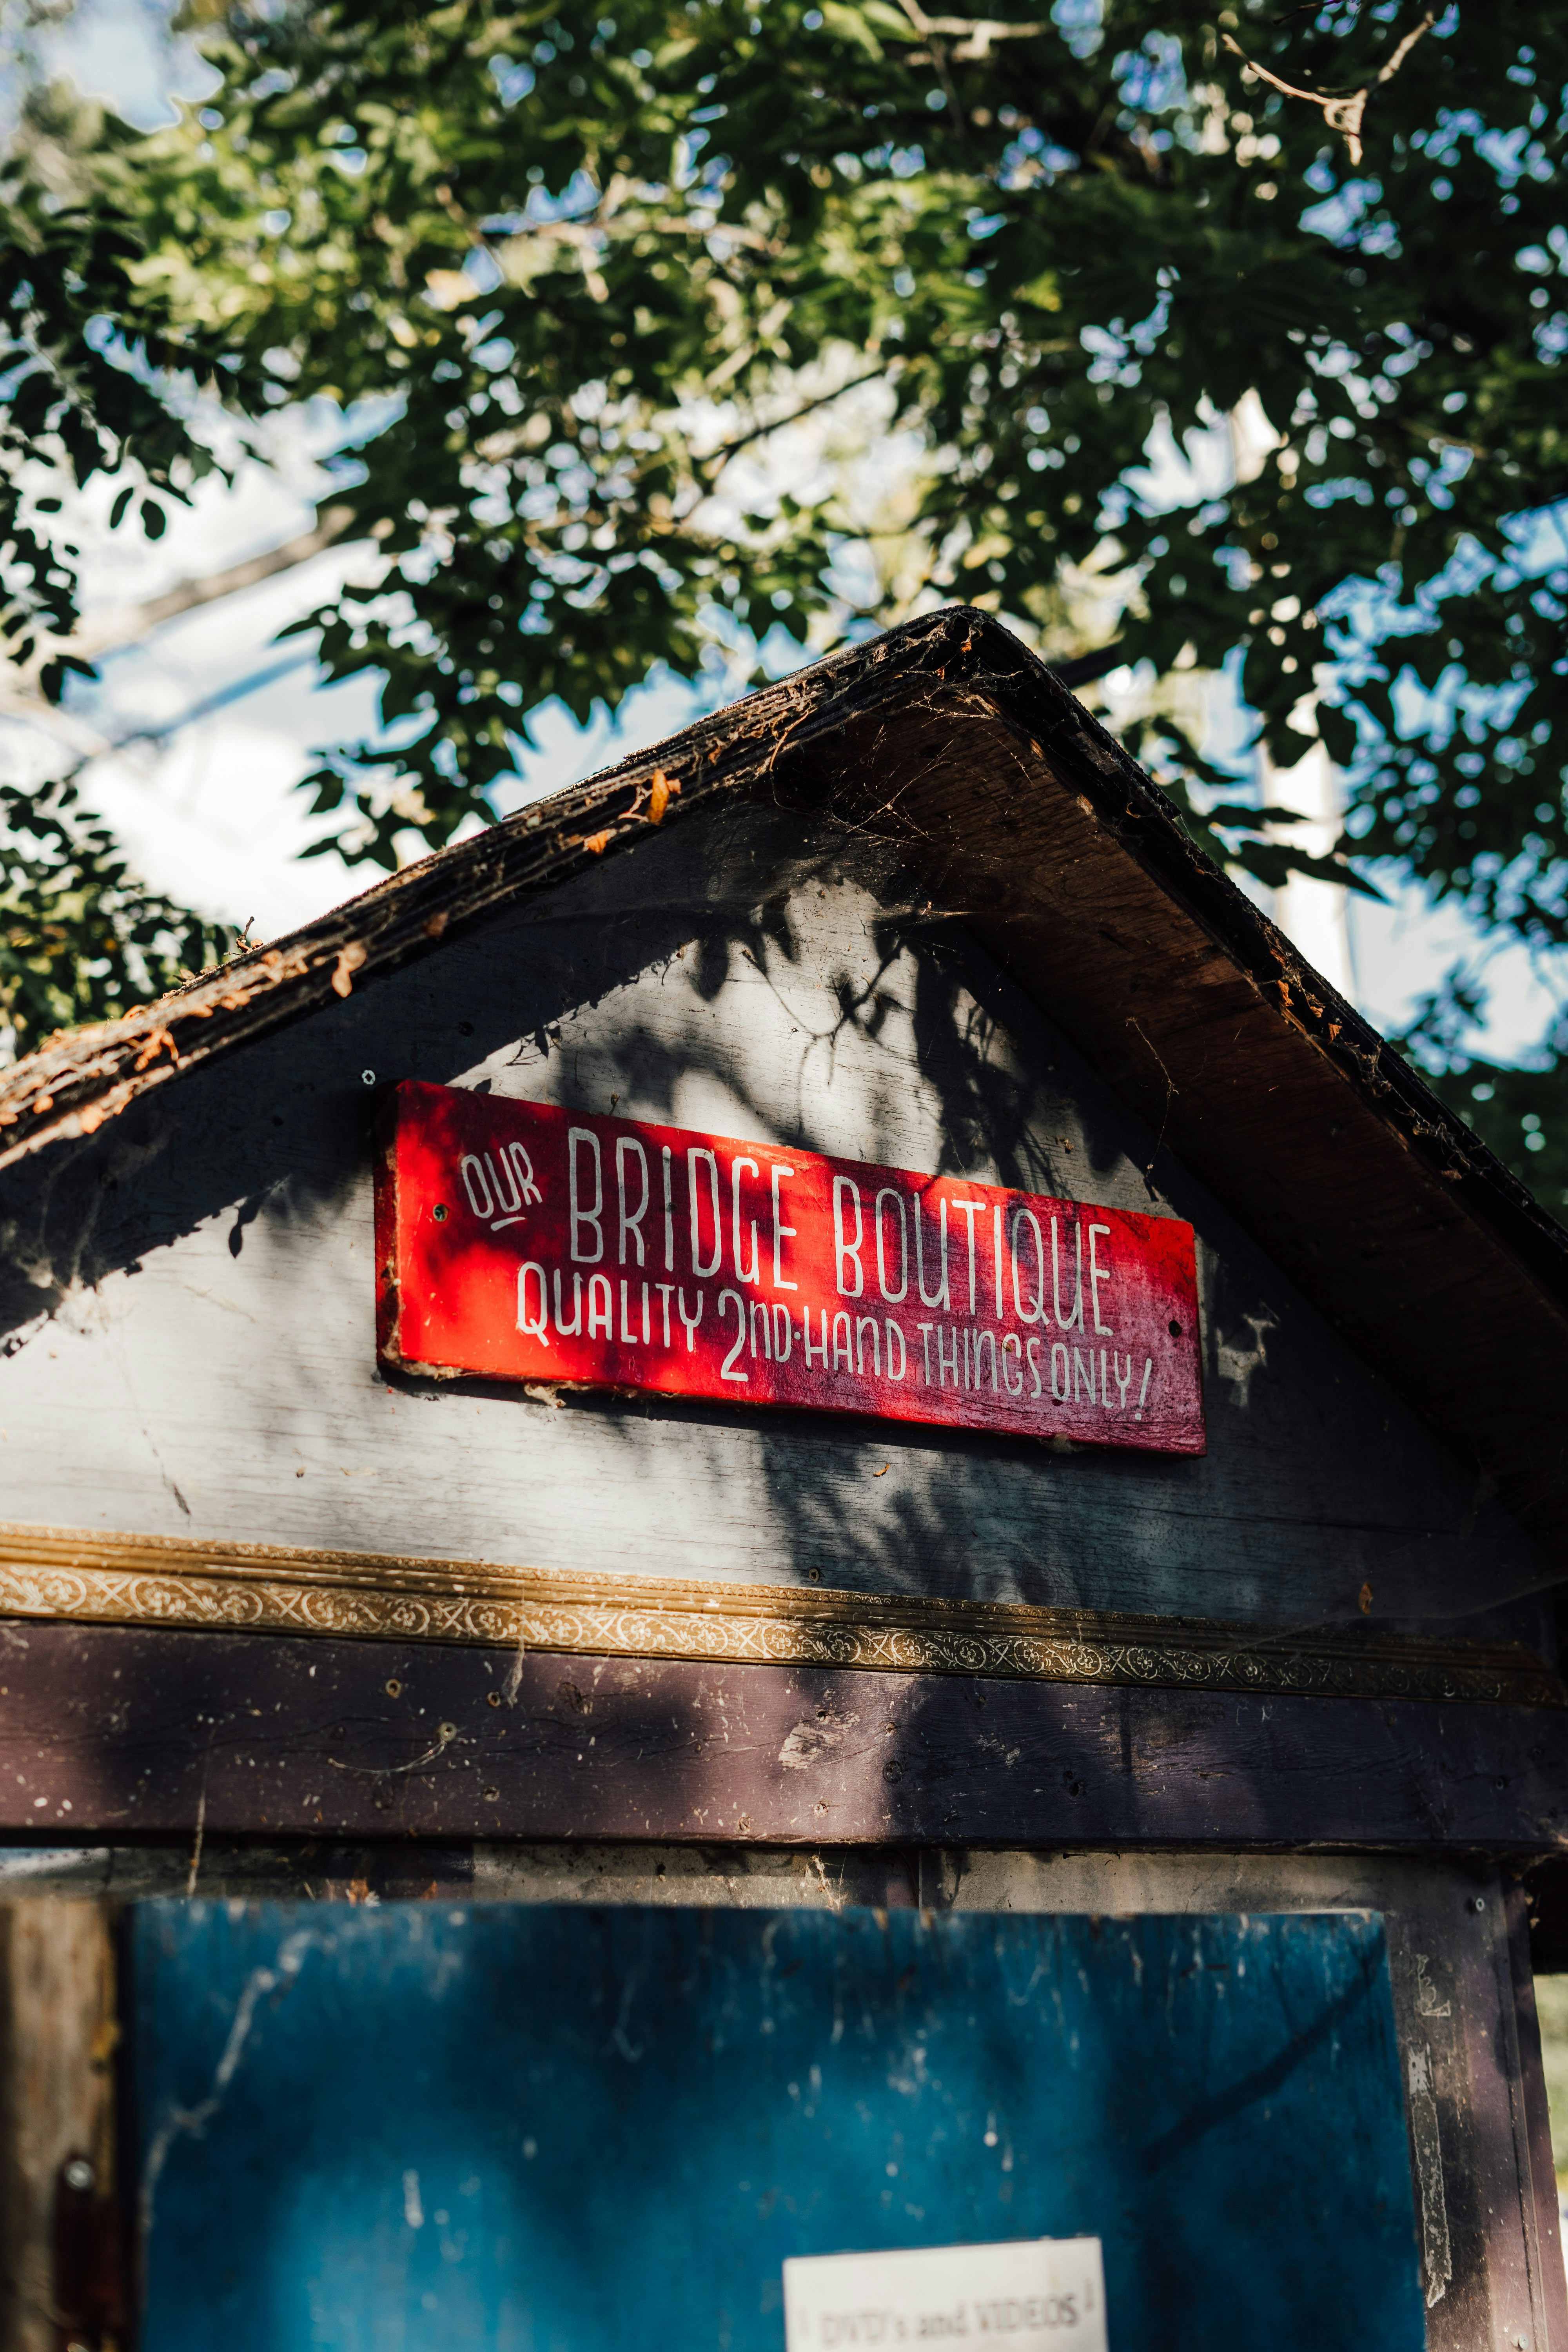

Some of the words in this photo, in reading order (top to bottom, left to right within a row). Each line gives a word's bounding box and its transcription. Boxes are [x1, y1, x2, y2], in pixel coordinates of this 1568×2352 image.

[461, 1142, 542, 1219] OUR
[568, 1127, 798, 1290] BRIDGE
[833, 1176, 1112, 1336] BOUTIQUE
[517, 1262, 704, 1352] QUALITY
[1051, 1343, 1152, 1421] ONLY!
[916, 2299, 967, 2340] and
[973, 2292, 1079, 2332] VIDEOS
